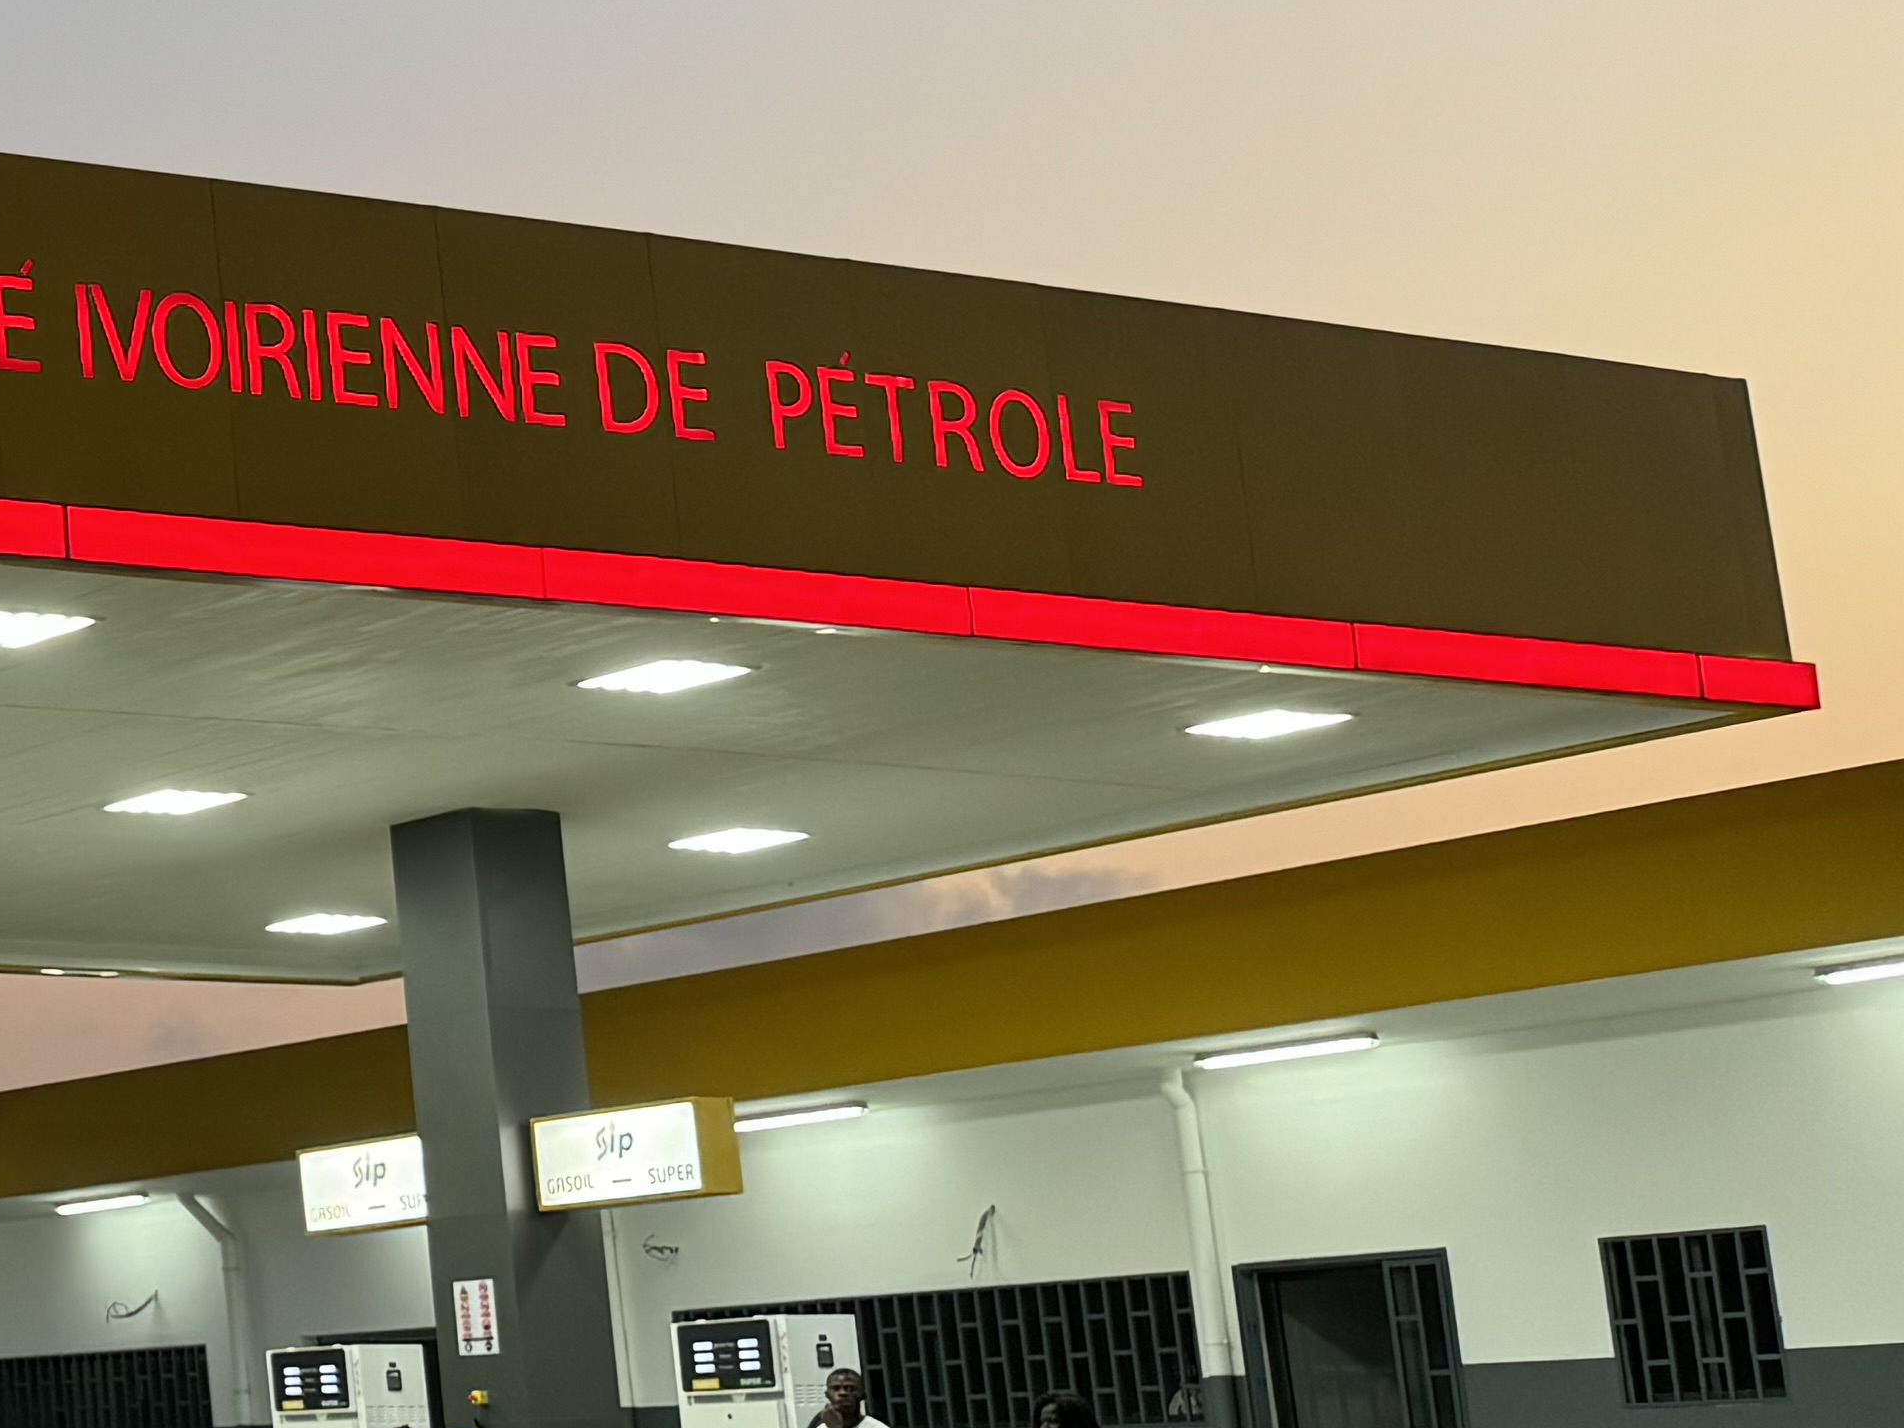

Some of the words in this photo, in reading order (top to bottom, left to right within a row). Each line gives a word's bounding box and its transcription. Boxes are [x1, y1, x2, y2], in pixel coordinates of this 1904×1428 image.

[74, 283, 567, 427] IVOIRIENNE
[593, 342, 715, 441] DE
[765, 352, 1144, 488] PÉTROLE
[547, 1174, 595, 1195] GASOIL
[648, 1164, 695, 1185] SUPER
